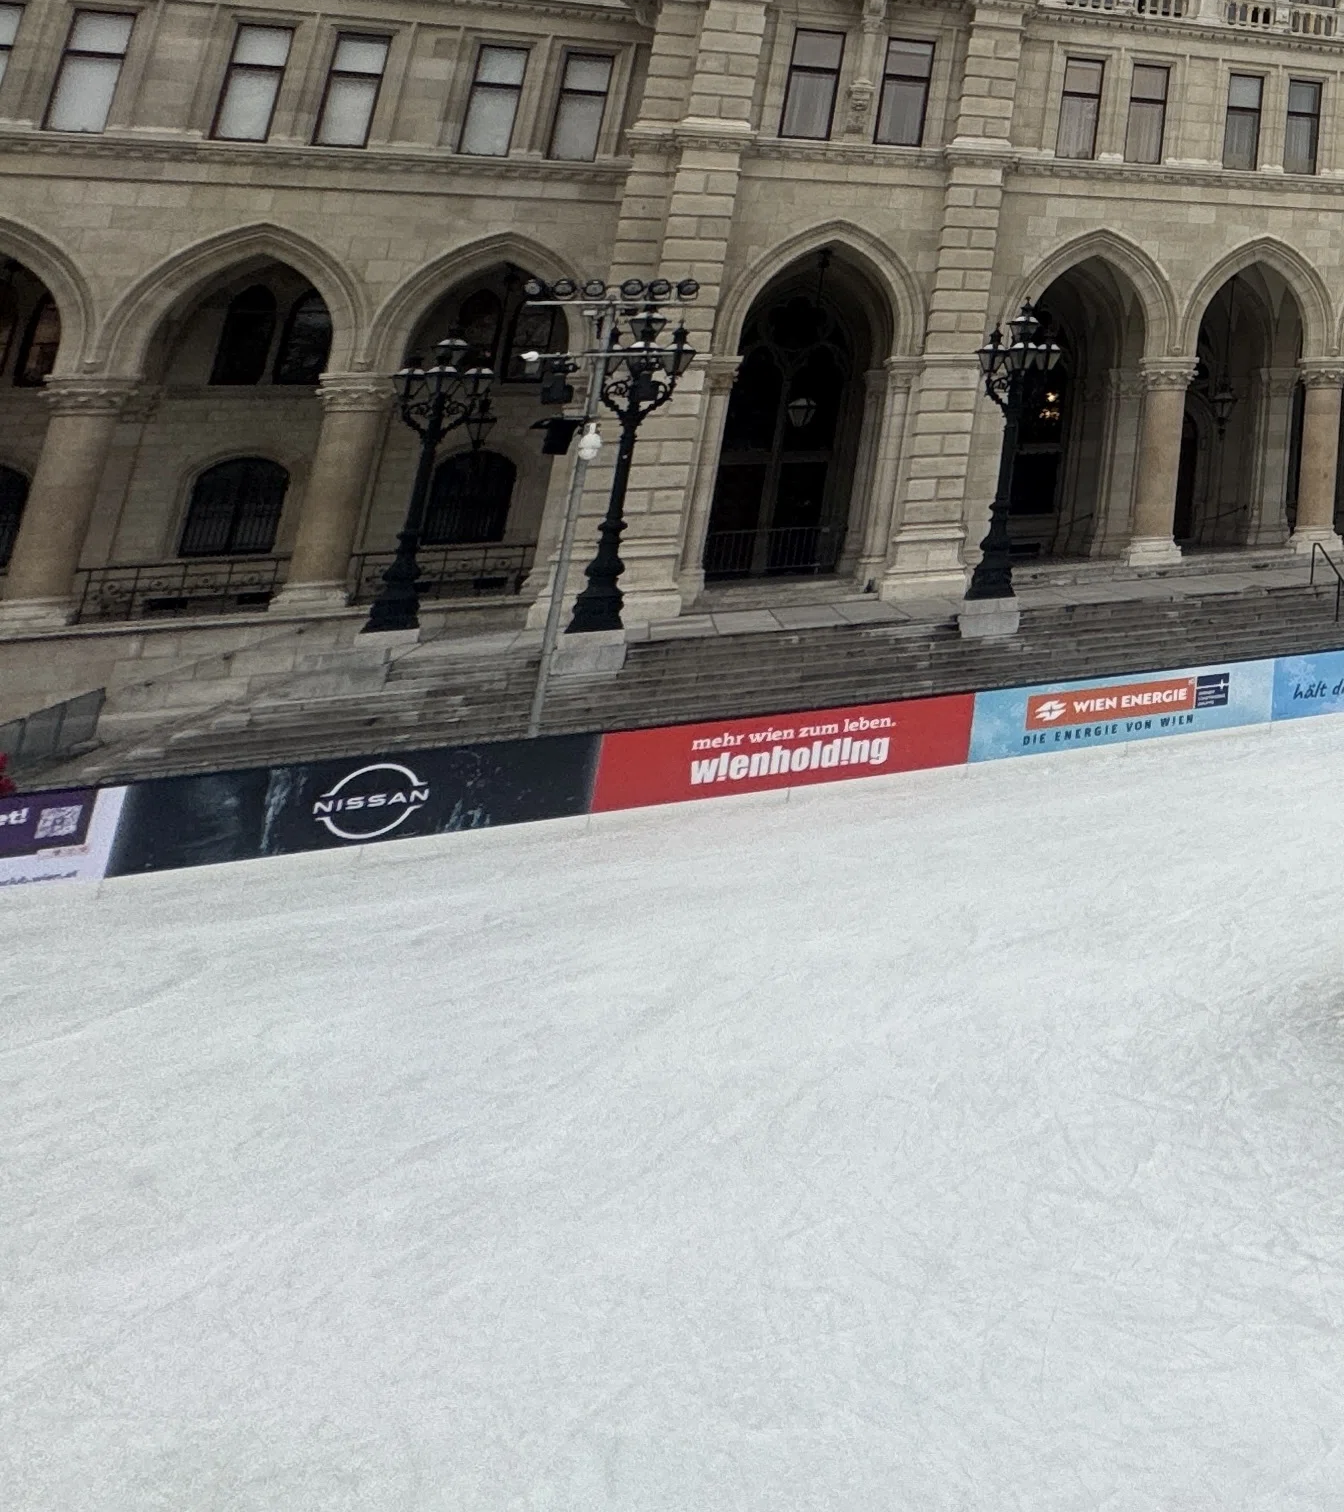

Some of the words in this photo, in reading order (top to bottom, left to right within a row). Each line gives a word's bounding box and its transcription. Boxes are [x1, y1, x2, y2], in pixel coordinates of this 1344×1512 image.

[1073, 697, 1118, 714] WIEN
[1121, 687, 1188, 708] ENERGIE
[1292, 683, 1328, 700] hält
[691, 732, 745, 752] mehr
[748, 726, 795, 744] wien
[798, 722, 840, 738] zum
[843, 716, 897, 733] leben.
[1022, 733, 1047, 747] DIE
[1054, 723, 1119, 742] ENERGIE
[1126, 719, 1152, 733] VON
[1160, 714, 1194, 727] WIEN
[312, 788, 430, 815] NISSAN
